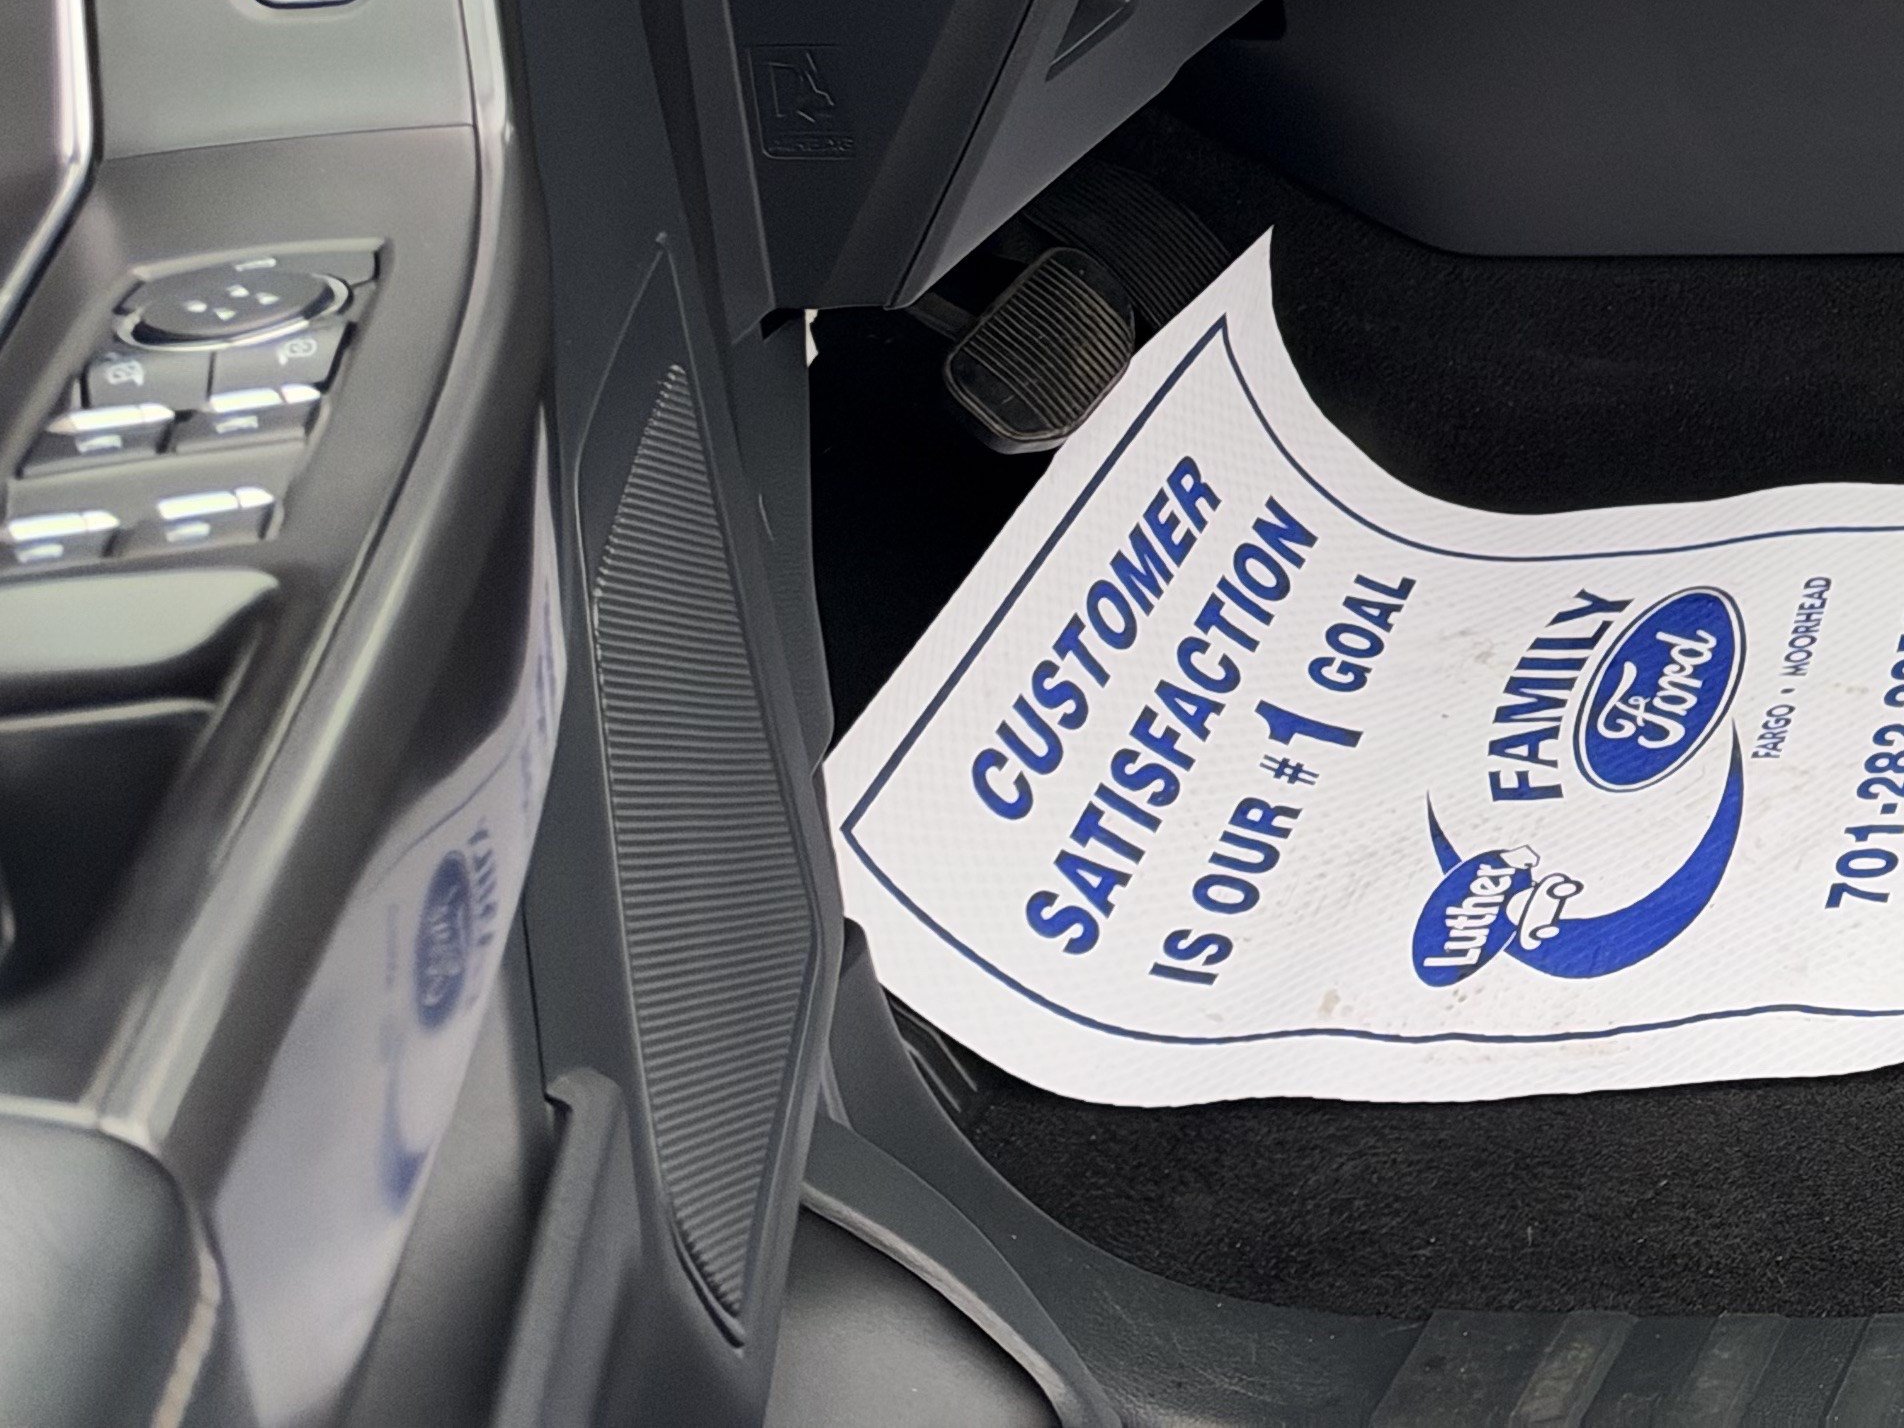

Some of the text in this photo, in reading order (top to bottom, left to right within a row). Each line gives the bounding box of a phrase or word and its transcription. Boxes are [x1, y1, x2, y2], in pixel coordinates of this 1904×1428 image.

[972, 455, 1222, 821] CUSTOMER
[1026, 495, 1318, 954] SATISFACTION
[1488, 588, 1635, 802] FAMILY
[1597, 629, 1717, 749] Ford
[1751, 576, 1832, 759] FARGO MOORHEAD
[1148, 929, 1234, 986] IS
[1192, 797, 1303, 915] OUR
[1308, 574, 1416, 693] GOAL
[1422, 862, 1517, 967] Luther
